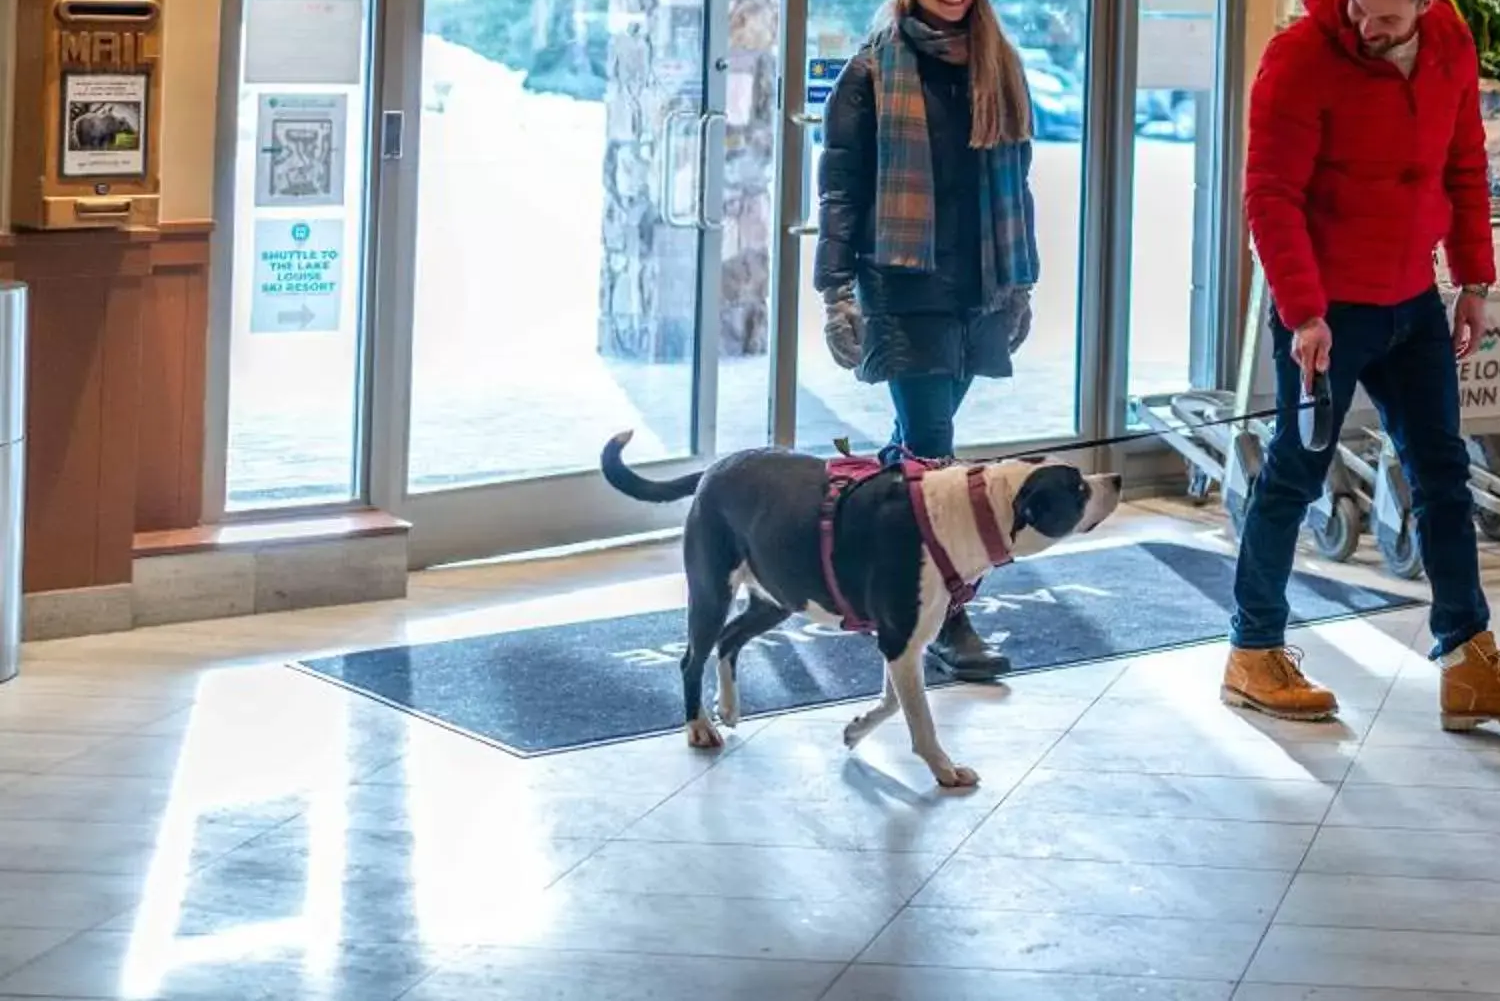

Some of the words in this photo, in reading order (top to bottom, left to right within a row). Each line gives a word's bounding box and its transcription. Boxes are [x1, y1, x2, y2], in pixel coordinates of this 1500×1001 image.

[61, 30, 150, 66] MAIL
[261, 250, 317, 261] SHUTTLE
[320, 250, 338, 260] TO
[270, 262, 293, 271] THE
[297, 261, 330, 270] LAKE
[277, 272, 321, 281] LOUISE
[261, 283, 282, 292] SKI
[285, 282, 335, 292] RESORT
